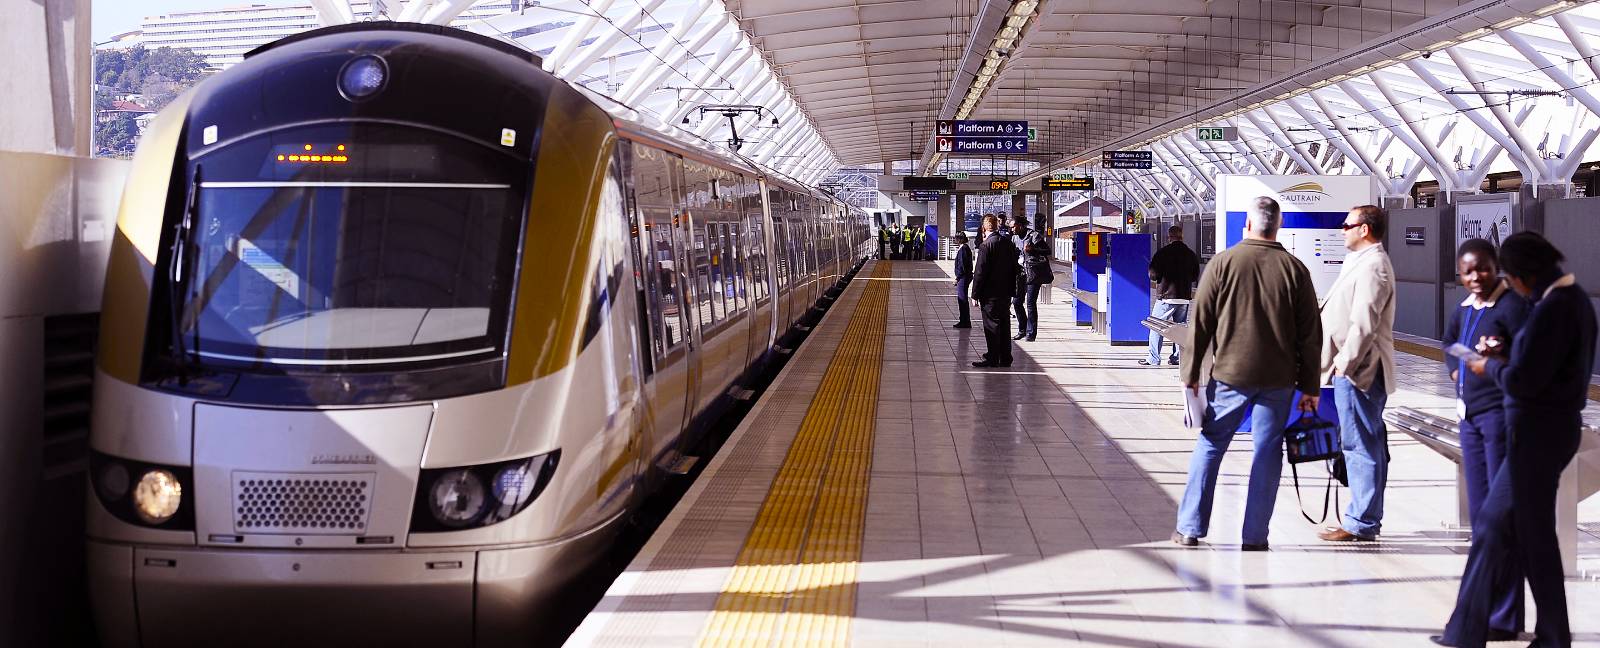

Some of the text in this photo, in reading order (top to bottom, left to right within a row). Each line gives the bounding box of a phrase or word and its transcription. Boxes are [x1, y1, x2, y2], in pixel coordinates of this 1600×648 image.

[958, 124, 1004, 133] Platform A
[958, 141, 995, 150] Platform
[997, 141, 1003, 149] B
[1279, 194, 1321, 202] GAUTRAIN
[1459, 213, 1482, 239] Welcome
